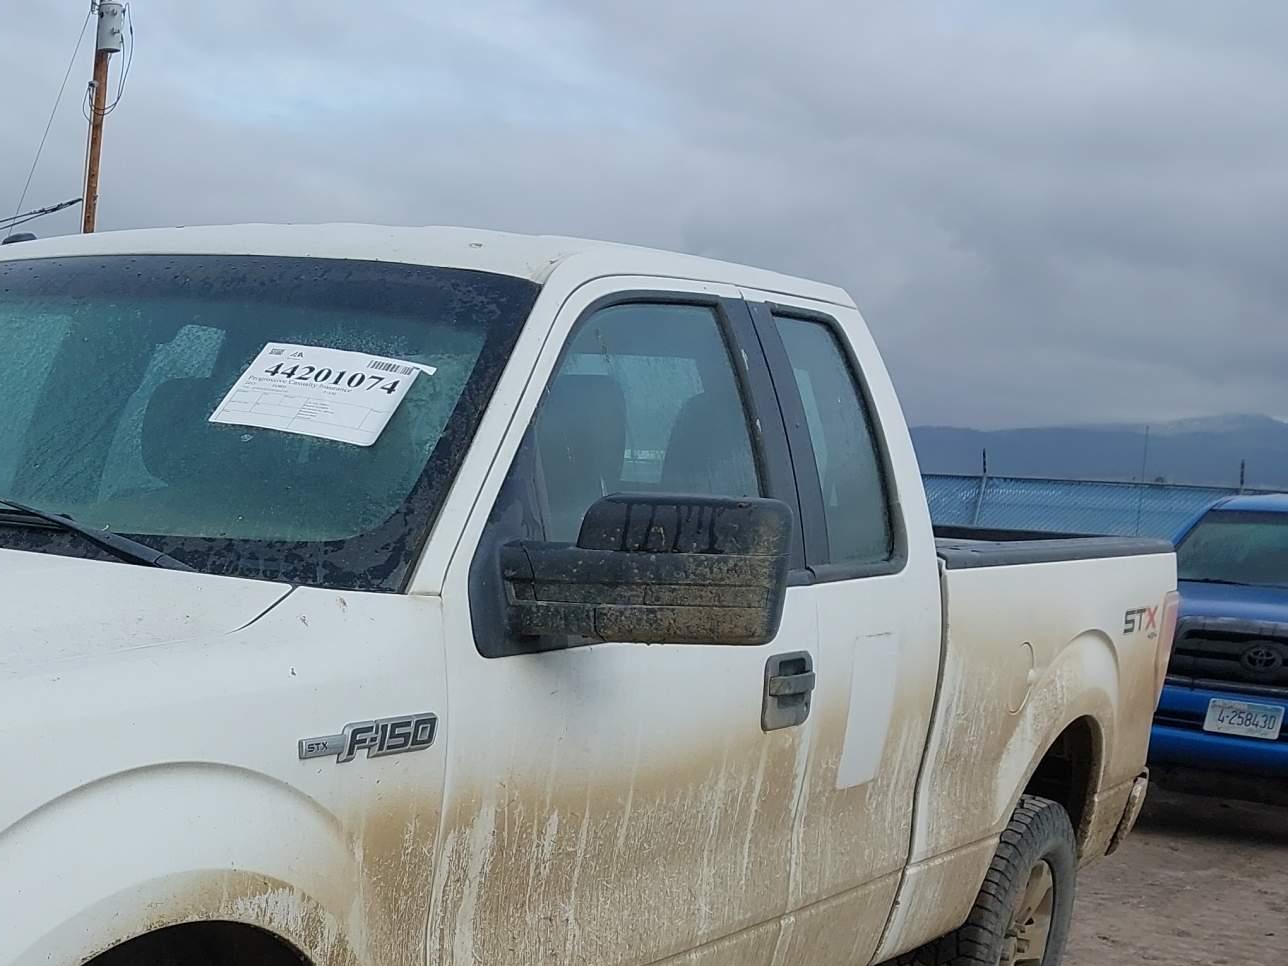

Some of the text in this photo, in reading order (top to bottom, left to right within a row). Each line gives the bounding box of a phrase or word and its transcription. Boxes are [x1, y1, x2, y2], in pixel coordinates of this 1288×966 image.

[264, 362, 401, 395] 44201074
[1123, 605, 1158, 634] STX
[307, 713, 439, 760] STX F-150
